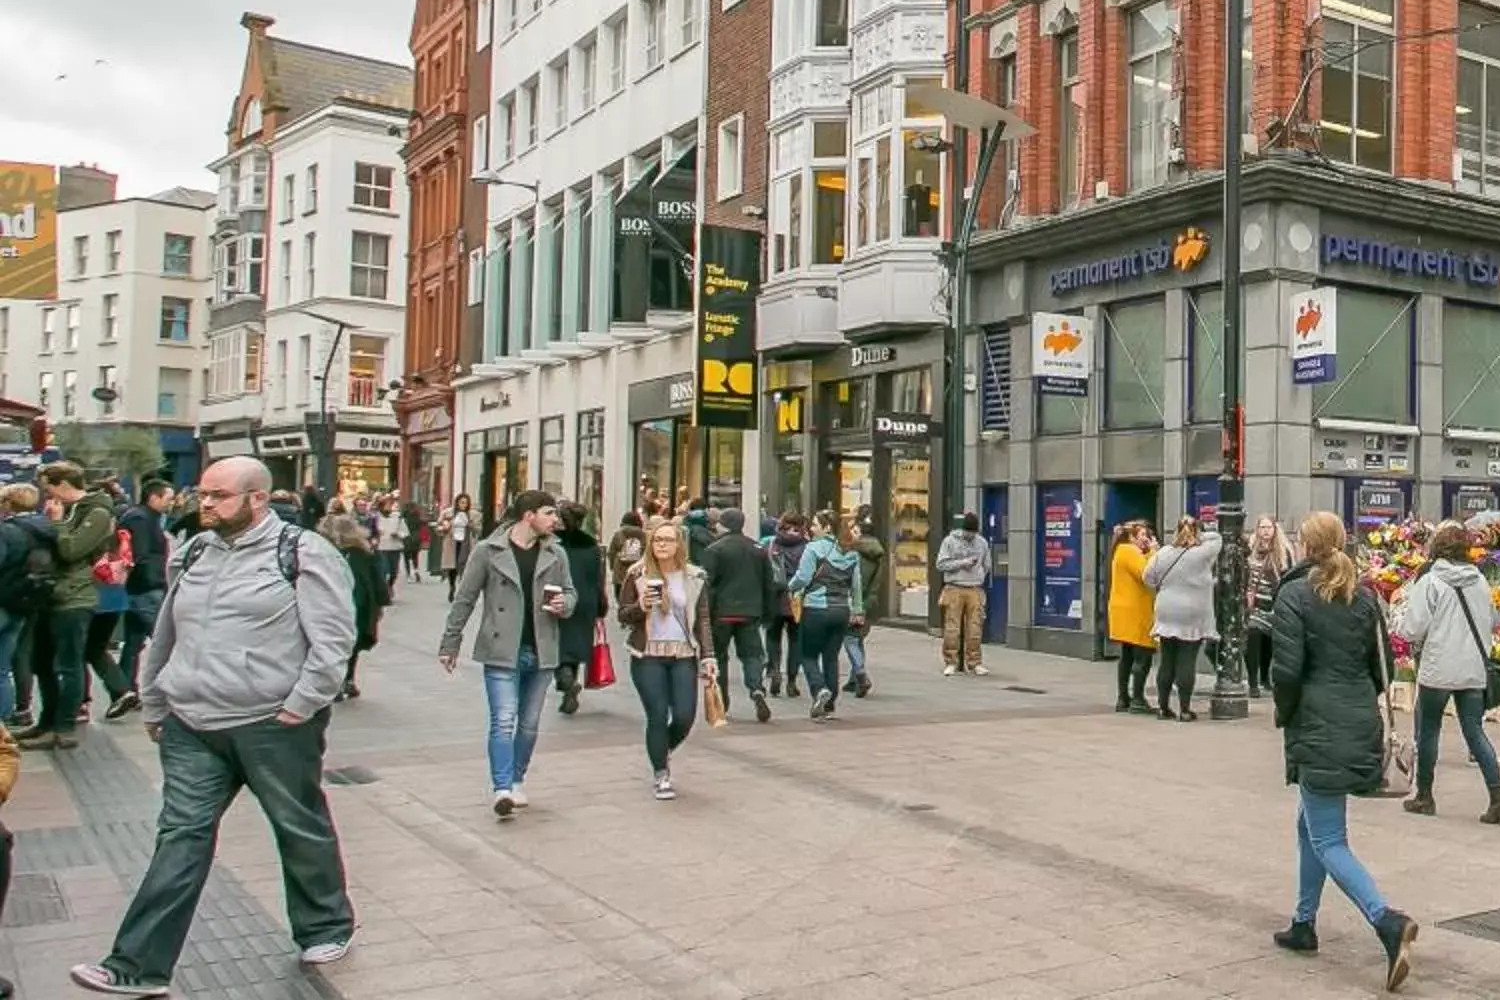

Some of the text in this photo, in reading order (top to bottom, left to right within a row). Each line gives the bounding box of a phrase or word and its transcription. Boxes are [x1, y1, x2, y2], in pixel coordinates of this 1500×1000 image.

[1323, 233, 1500, 284] permanent tsb
[1049, 240, 1170, 297] permanent tsb
[851, 347, 890, 367] Dune
[876, 417, 929, 433] Dune
[1369, 493, 1392, 505] ATM
[1467, 498, 1487, 509] ATM
